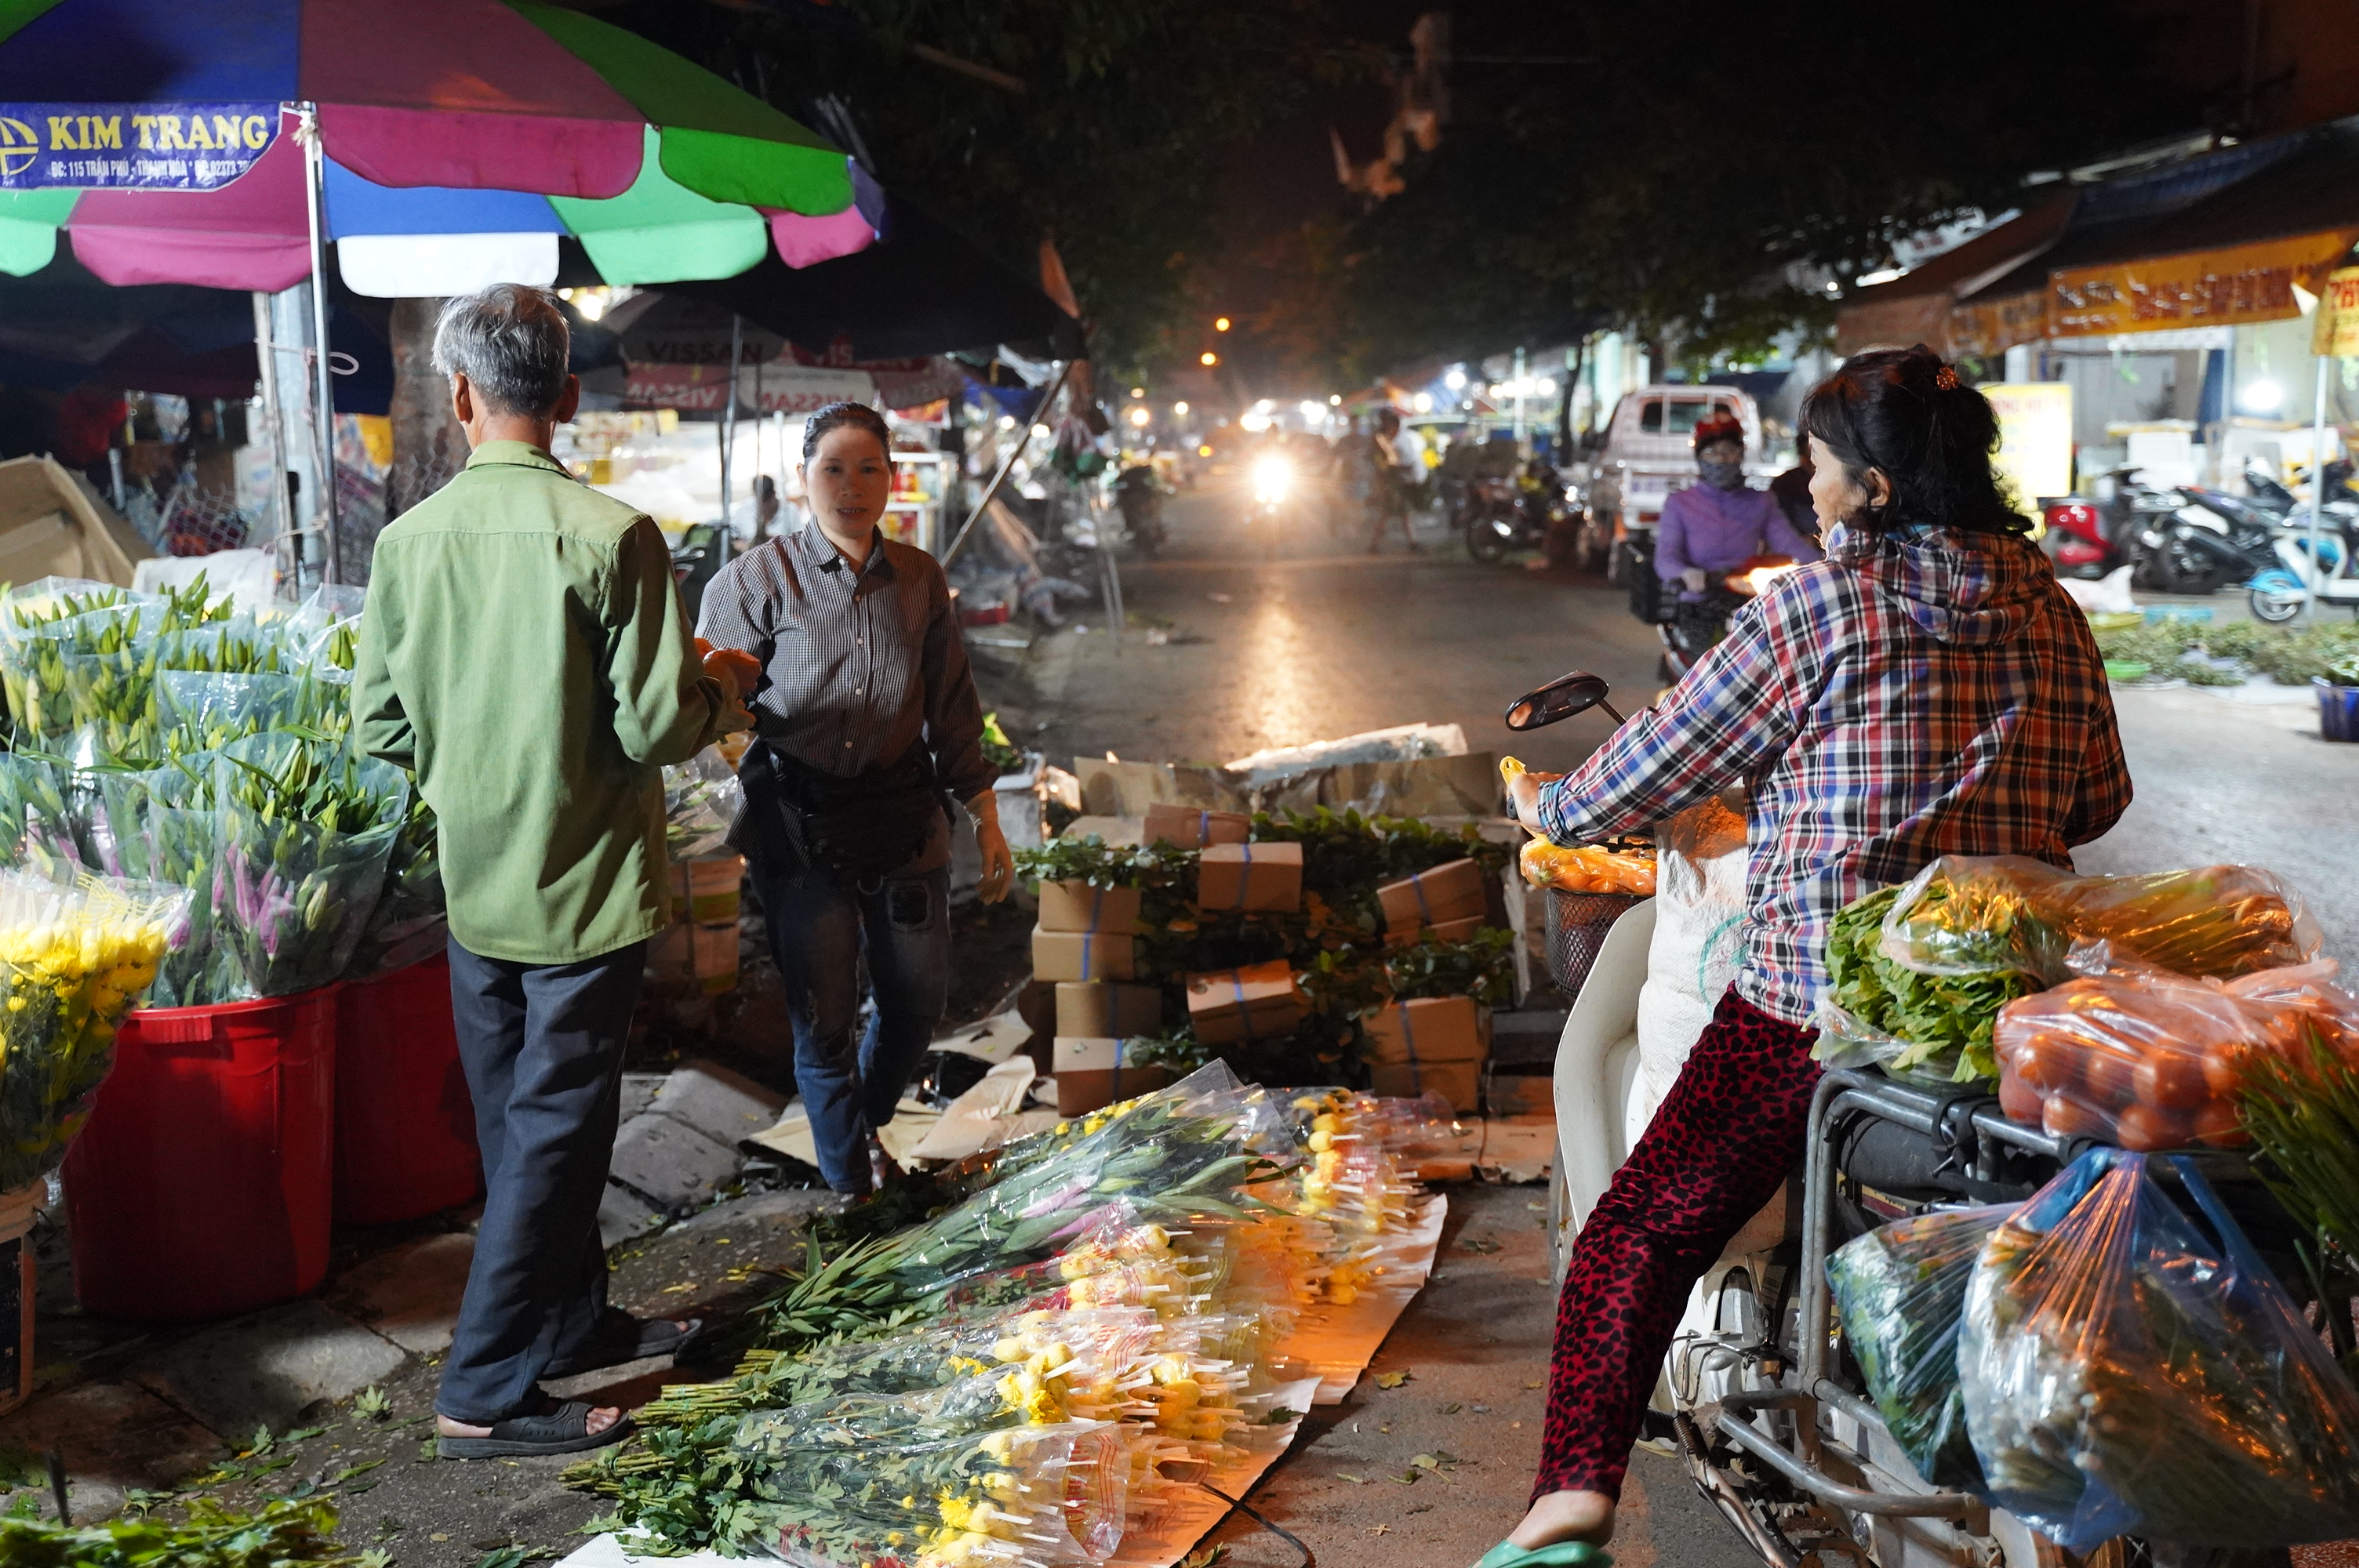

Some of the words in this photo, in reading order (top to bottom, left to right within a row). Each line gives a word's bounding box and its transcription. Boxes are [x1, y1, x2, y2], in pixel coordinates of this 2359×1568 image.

[48, 115, 123, 151] KIM
[132, 114, 269, 150] TRANG
[68, 161, 85, 177] 115
[110, 156, 129, 176] PHÚ
[646, 340, 762, 364] VISSAN
